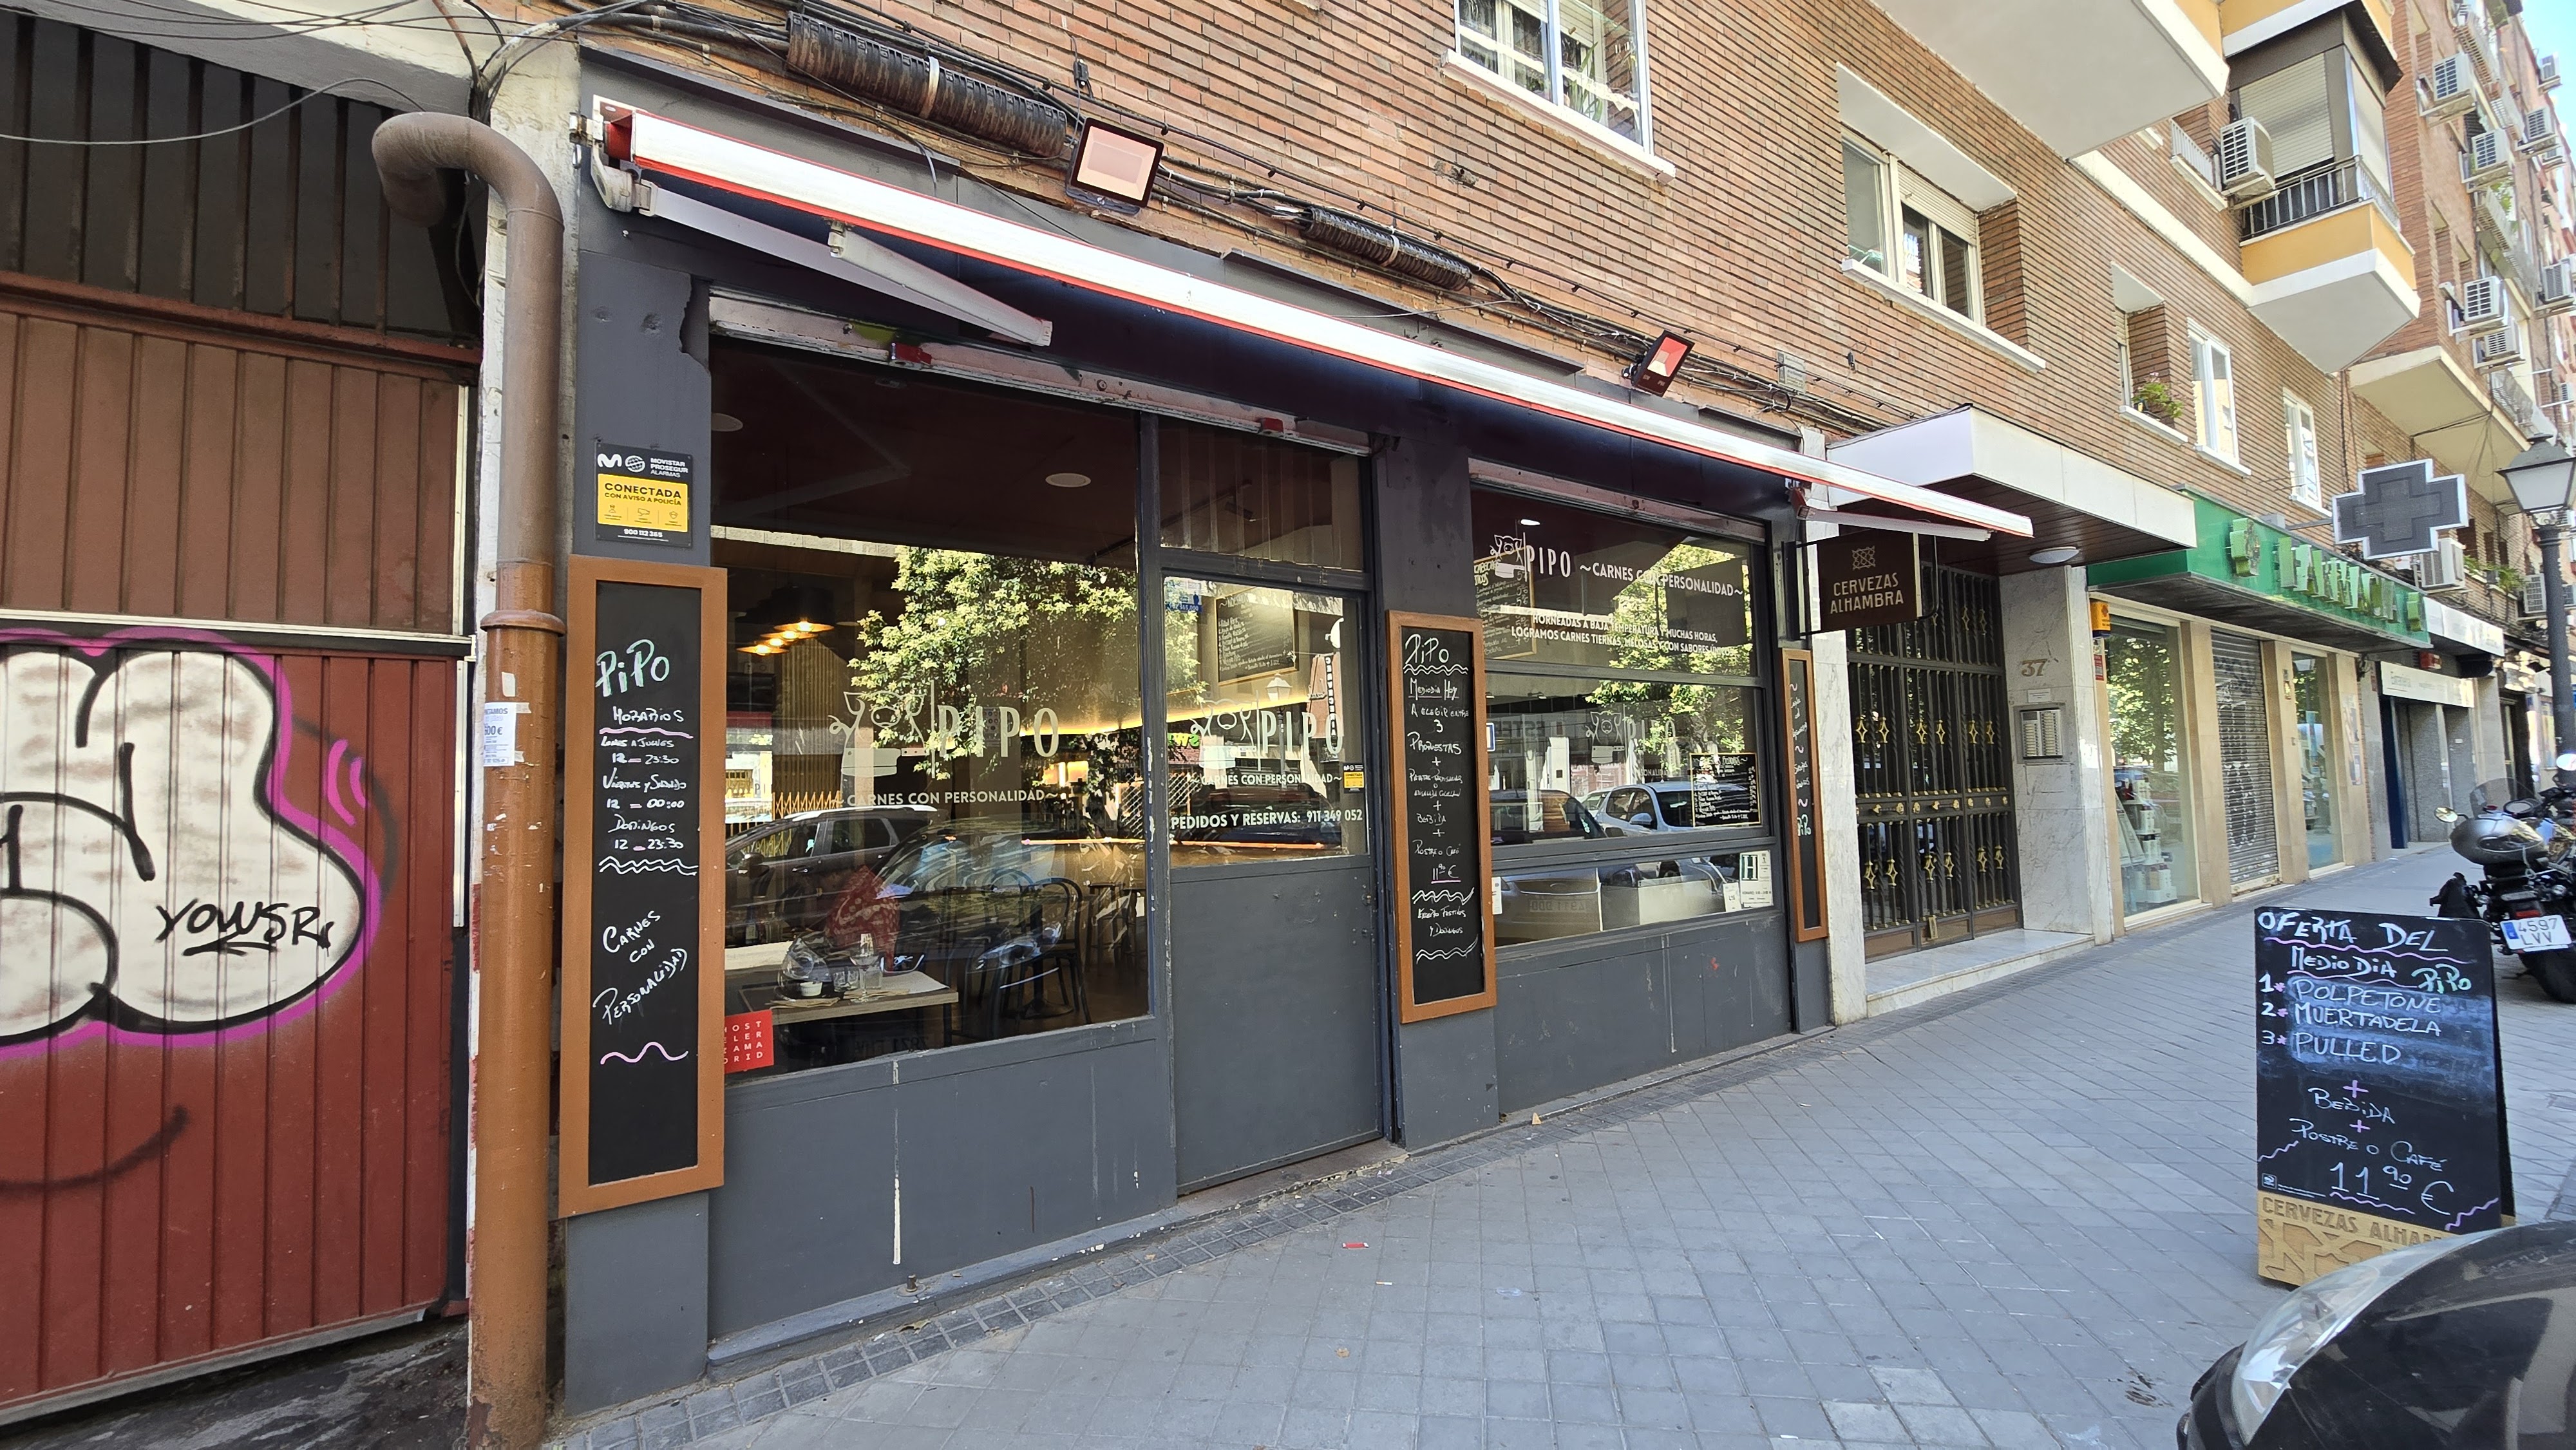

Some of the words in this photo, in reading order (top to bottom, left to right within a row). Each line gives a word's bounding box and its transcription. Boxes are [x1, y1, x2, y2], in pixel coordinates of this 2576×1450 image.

[650, 458, 685, 467] MOVISTAR
[650, 464, 688, 473] PROSEGUR
[605, 483, 682, 499] CONECTADA
[1526, 545, 1571, 577] PIPO
[1593, 562, 1634, 581] CARNES
[1636, 569, 1662, 585] CON
[1663, 572, 1734, 597] PERSONALIDAD
[1834, 572, 1899, 597] CERVEZAS
[1830, 590, 1904, 614] ALHAMBRA
[1533, 614, 1581, 628] HORNEADAS
[1591, 621, 1609, 631] BAJA
[1667, 628, 1693, 639] MUCHAS
[1694, 631, 1718, 643] HORAS,
[1511, 626, 1558, 640] LOGRAMOS
[1560, 631, 1590, 643] CARNES
[1664, 641, 1679, 651] CON
[1680, 643, 1709, 654] SABORES
[2021, 659, 2047, 677] 37
[938, 705, 1059, 758] PIPO
[1261, 710, 1343, 754] PIPO
[1434, 719, 1444, 733] 3
[612, 753, 627, 763] 12
[645, 755, 679, 764] 23:30
[1201, 775, 1238, 786] CARNES
[1240, 775, 1262, 785] CON
[607, 798, 620, 809] 12
[647, 798, 685, 809] 00:00
[847, 792, 904, 806] CARNES
[908, 792, 940, 805] CON
[945, 789, 1045, 804] PERSONALIDAD
[1171, 814, 1227, 830] PEDIDOS
[1231, 813, 1239, 827] Y
[1243, 812, 1301, 826] RESERVAS:
[1307, 810, 1321, 823] 911
[1323, 809, 1341, 822] 349
[1345, 809, 1363, 821] 052
[615, 839, 629, 849] 12
[647, 838, 683, 849] 23:30
[2258, 912, 2357, 943] OFERTA
[2373, 922, 2448, 952] DEL
[2518, 918, 2558, 932] 4597
[2520, 931, 2552, 946] LVV
[2293, 977, 2441, 1013] POLPETONE
[2294, 1001, 2441, 1037] MUERTADELA
[2294, 1031, 2401, 1065] PULLED
[2262, 1196, 2358, 1234] CERVEZAS
